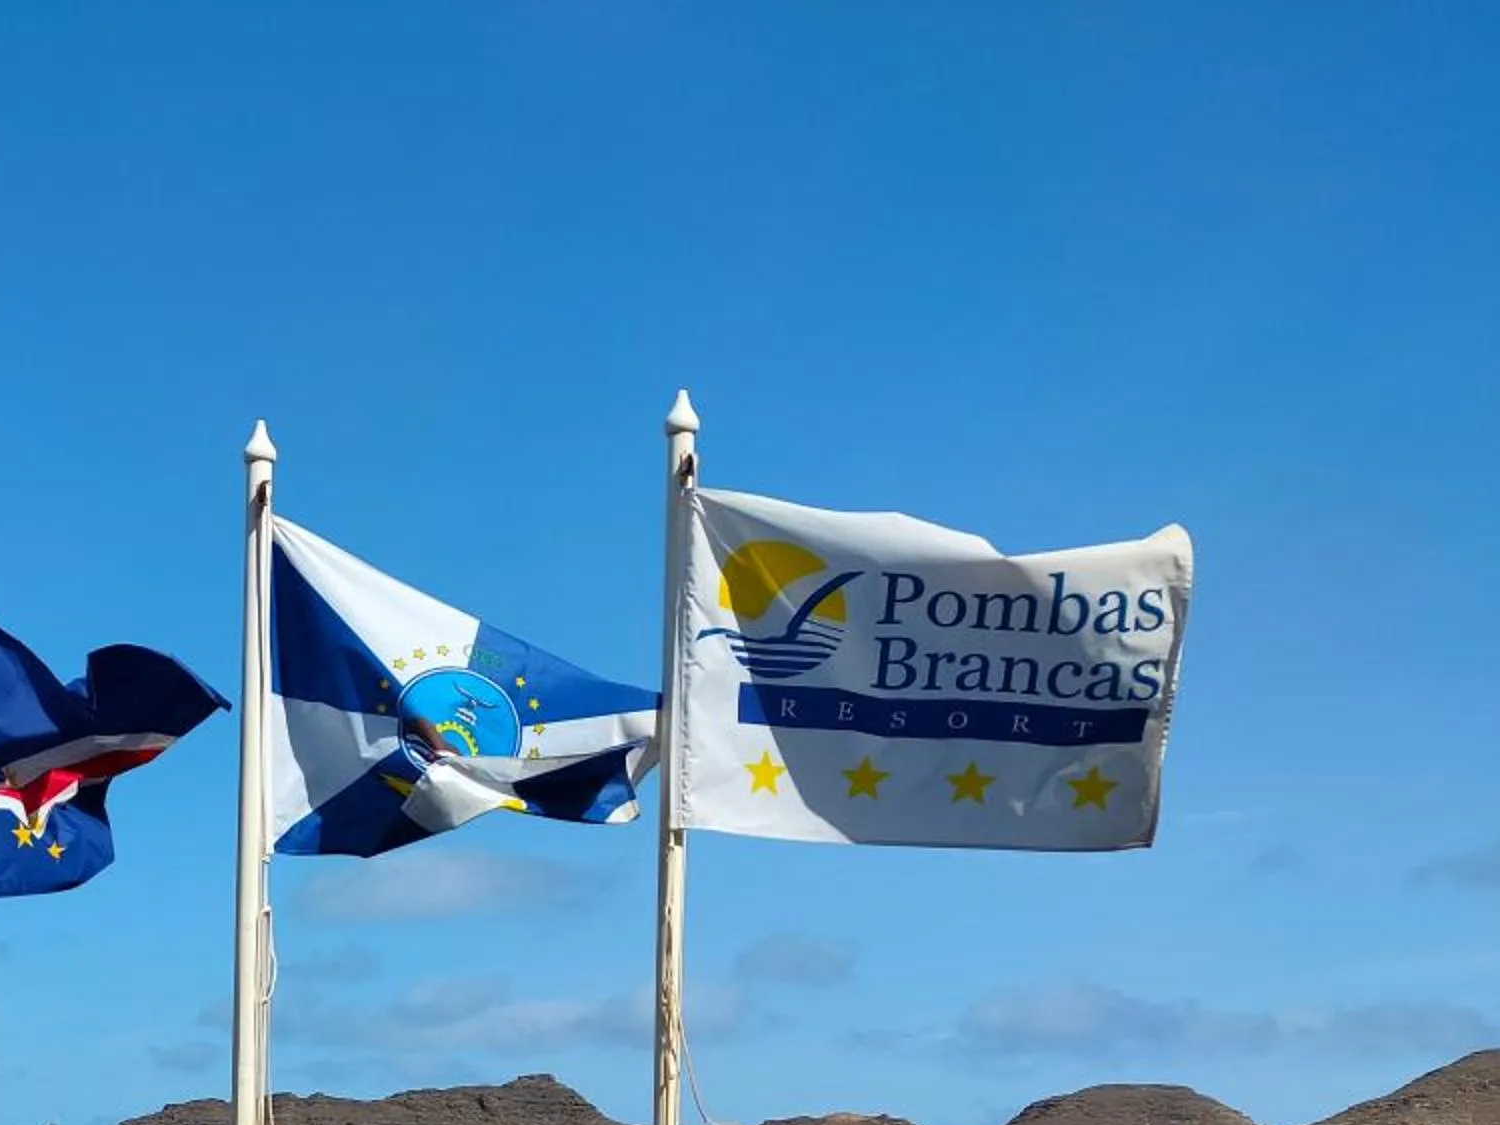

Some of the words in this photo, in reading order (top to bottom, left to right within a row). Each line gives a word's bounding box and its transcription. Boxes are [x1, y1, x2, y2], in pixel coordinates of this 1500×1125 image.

[875, 570, 1166, 635] Pombas
[870, 635, 1161, 702] Brancas
[780, 698, 1093, 738] RESORT
